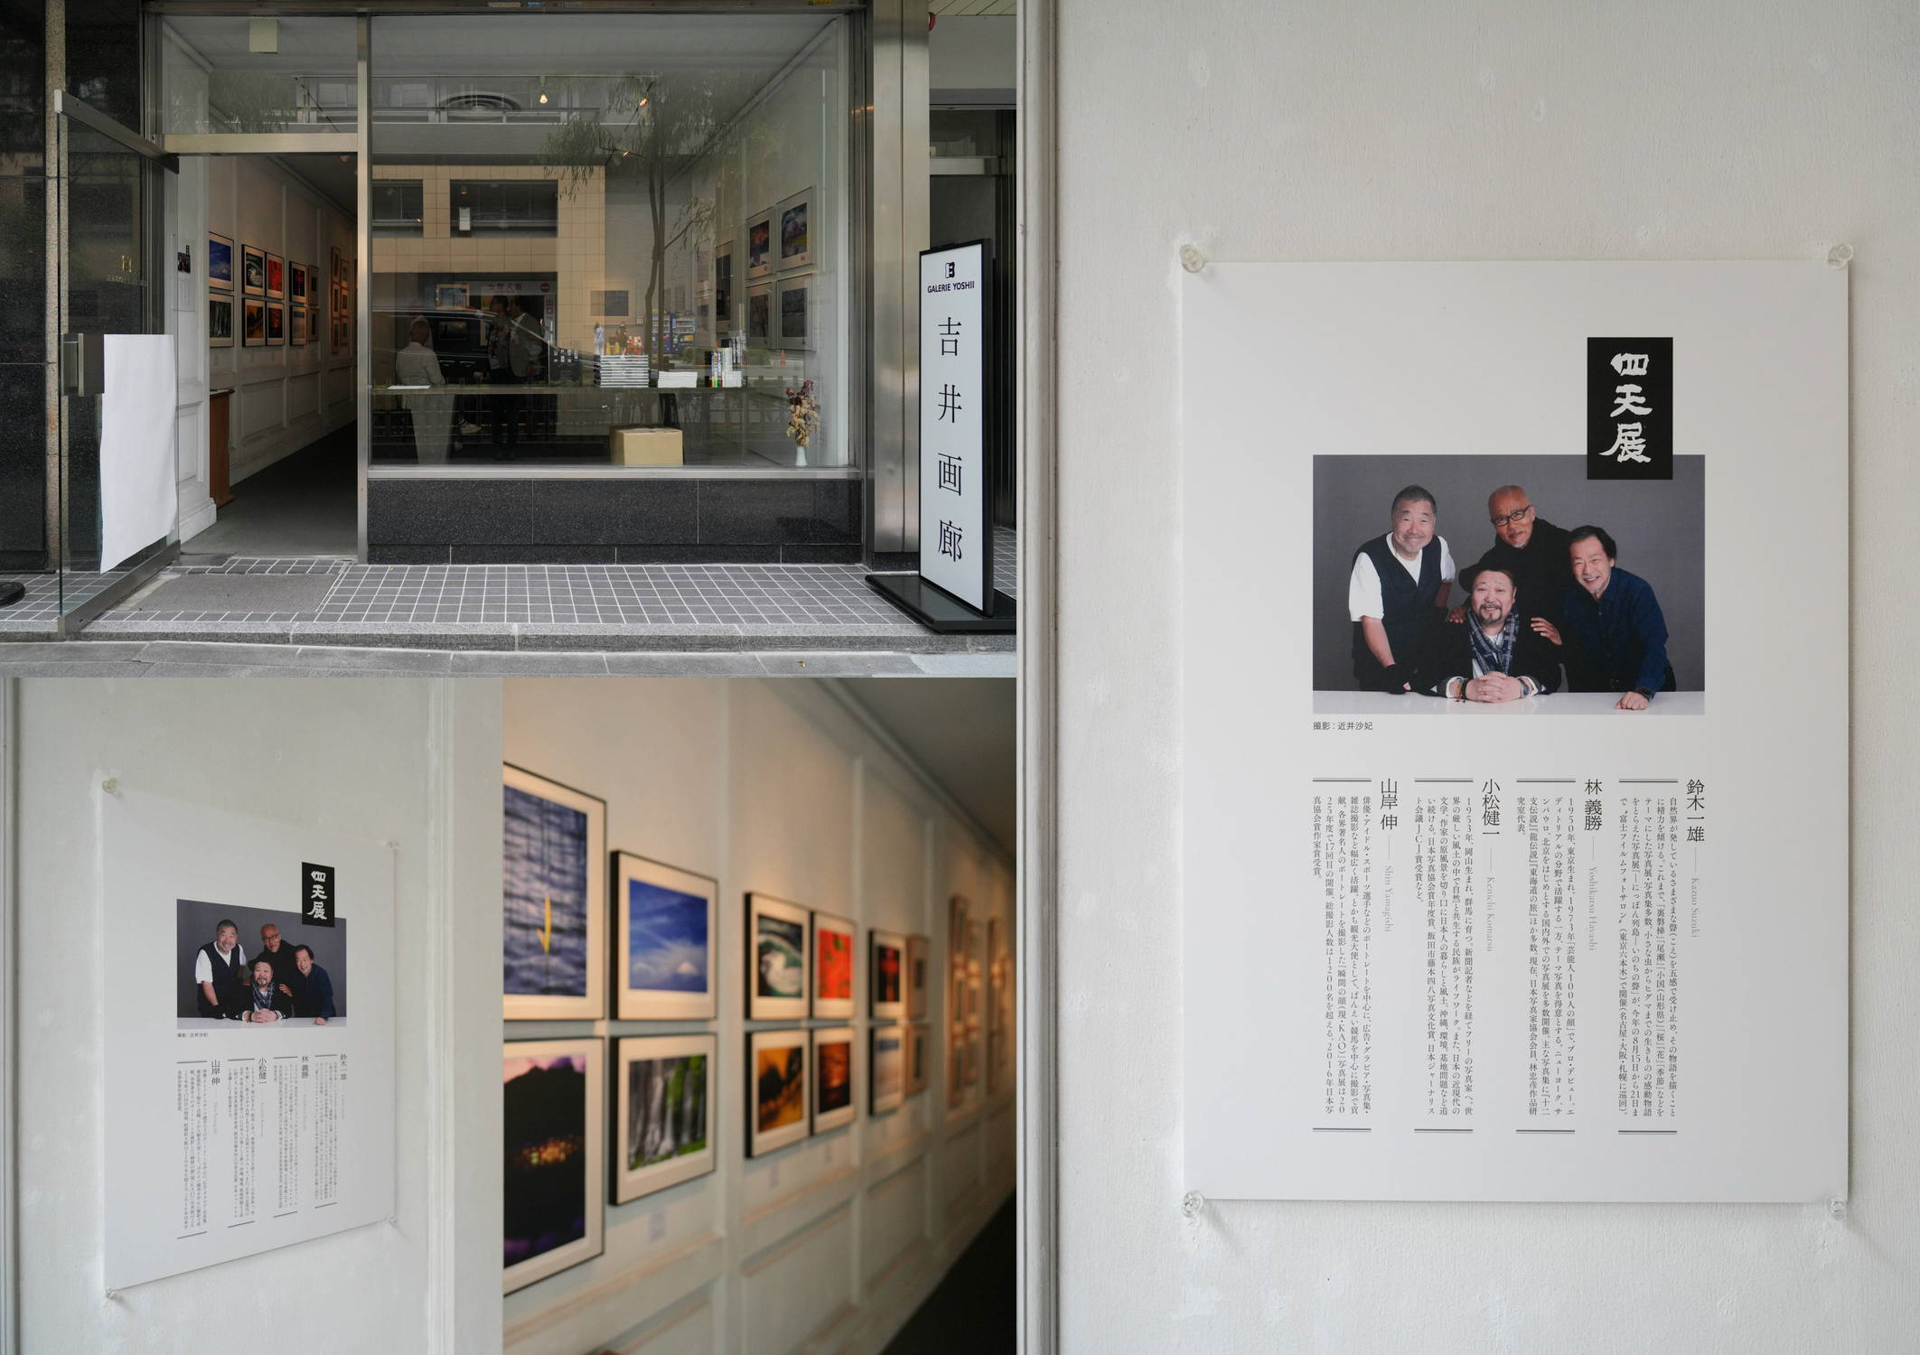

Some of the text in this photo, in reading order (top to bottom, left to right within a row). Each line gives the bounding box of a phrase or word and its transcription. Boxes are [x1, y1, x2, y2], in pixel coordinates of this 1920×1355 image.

[927, 281, 975, 293] GALERIE YOSHII
[938, 316, 962, 562] 吉井画廊
[1599, 352, 1653, 464] 四天展
[1380, 778, 1398, 830] 山岸 伸
[1482, 778, 1500, 835] 小松健一
[1584, 778, 1602, 831] 林 義勝
[1686, 778, 1704, 842] 鈴木一雄
[306, 870, 328, 920] 四天展
[1382, 865, 1394, 932] Shin Yamagishi
[1486, 877, 1496, 952] Kenichi Komatsu
[1589, 866, 1598, 951] Yoshikatsu Hayashi
[1691, 877, 1700, 938] Kazuo Suzuki
